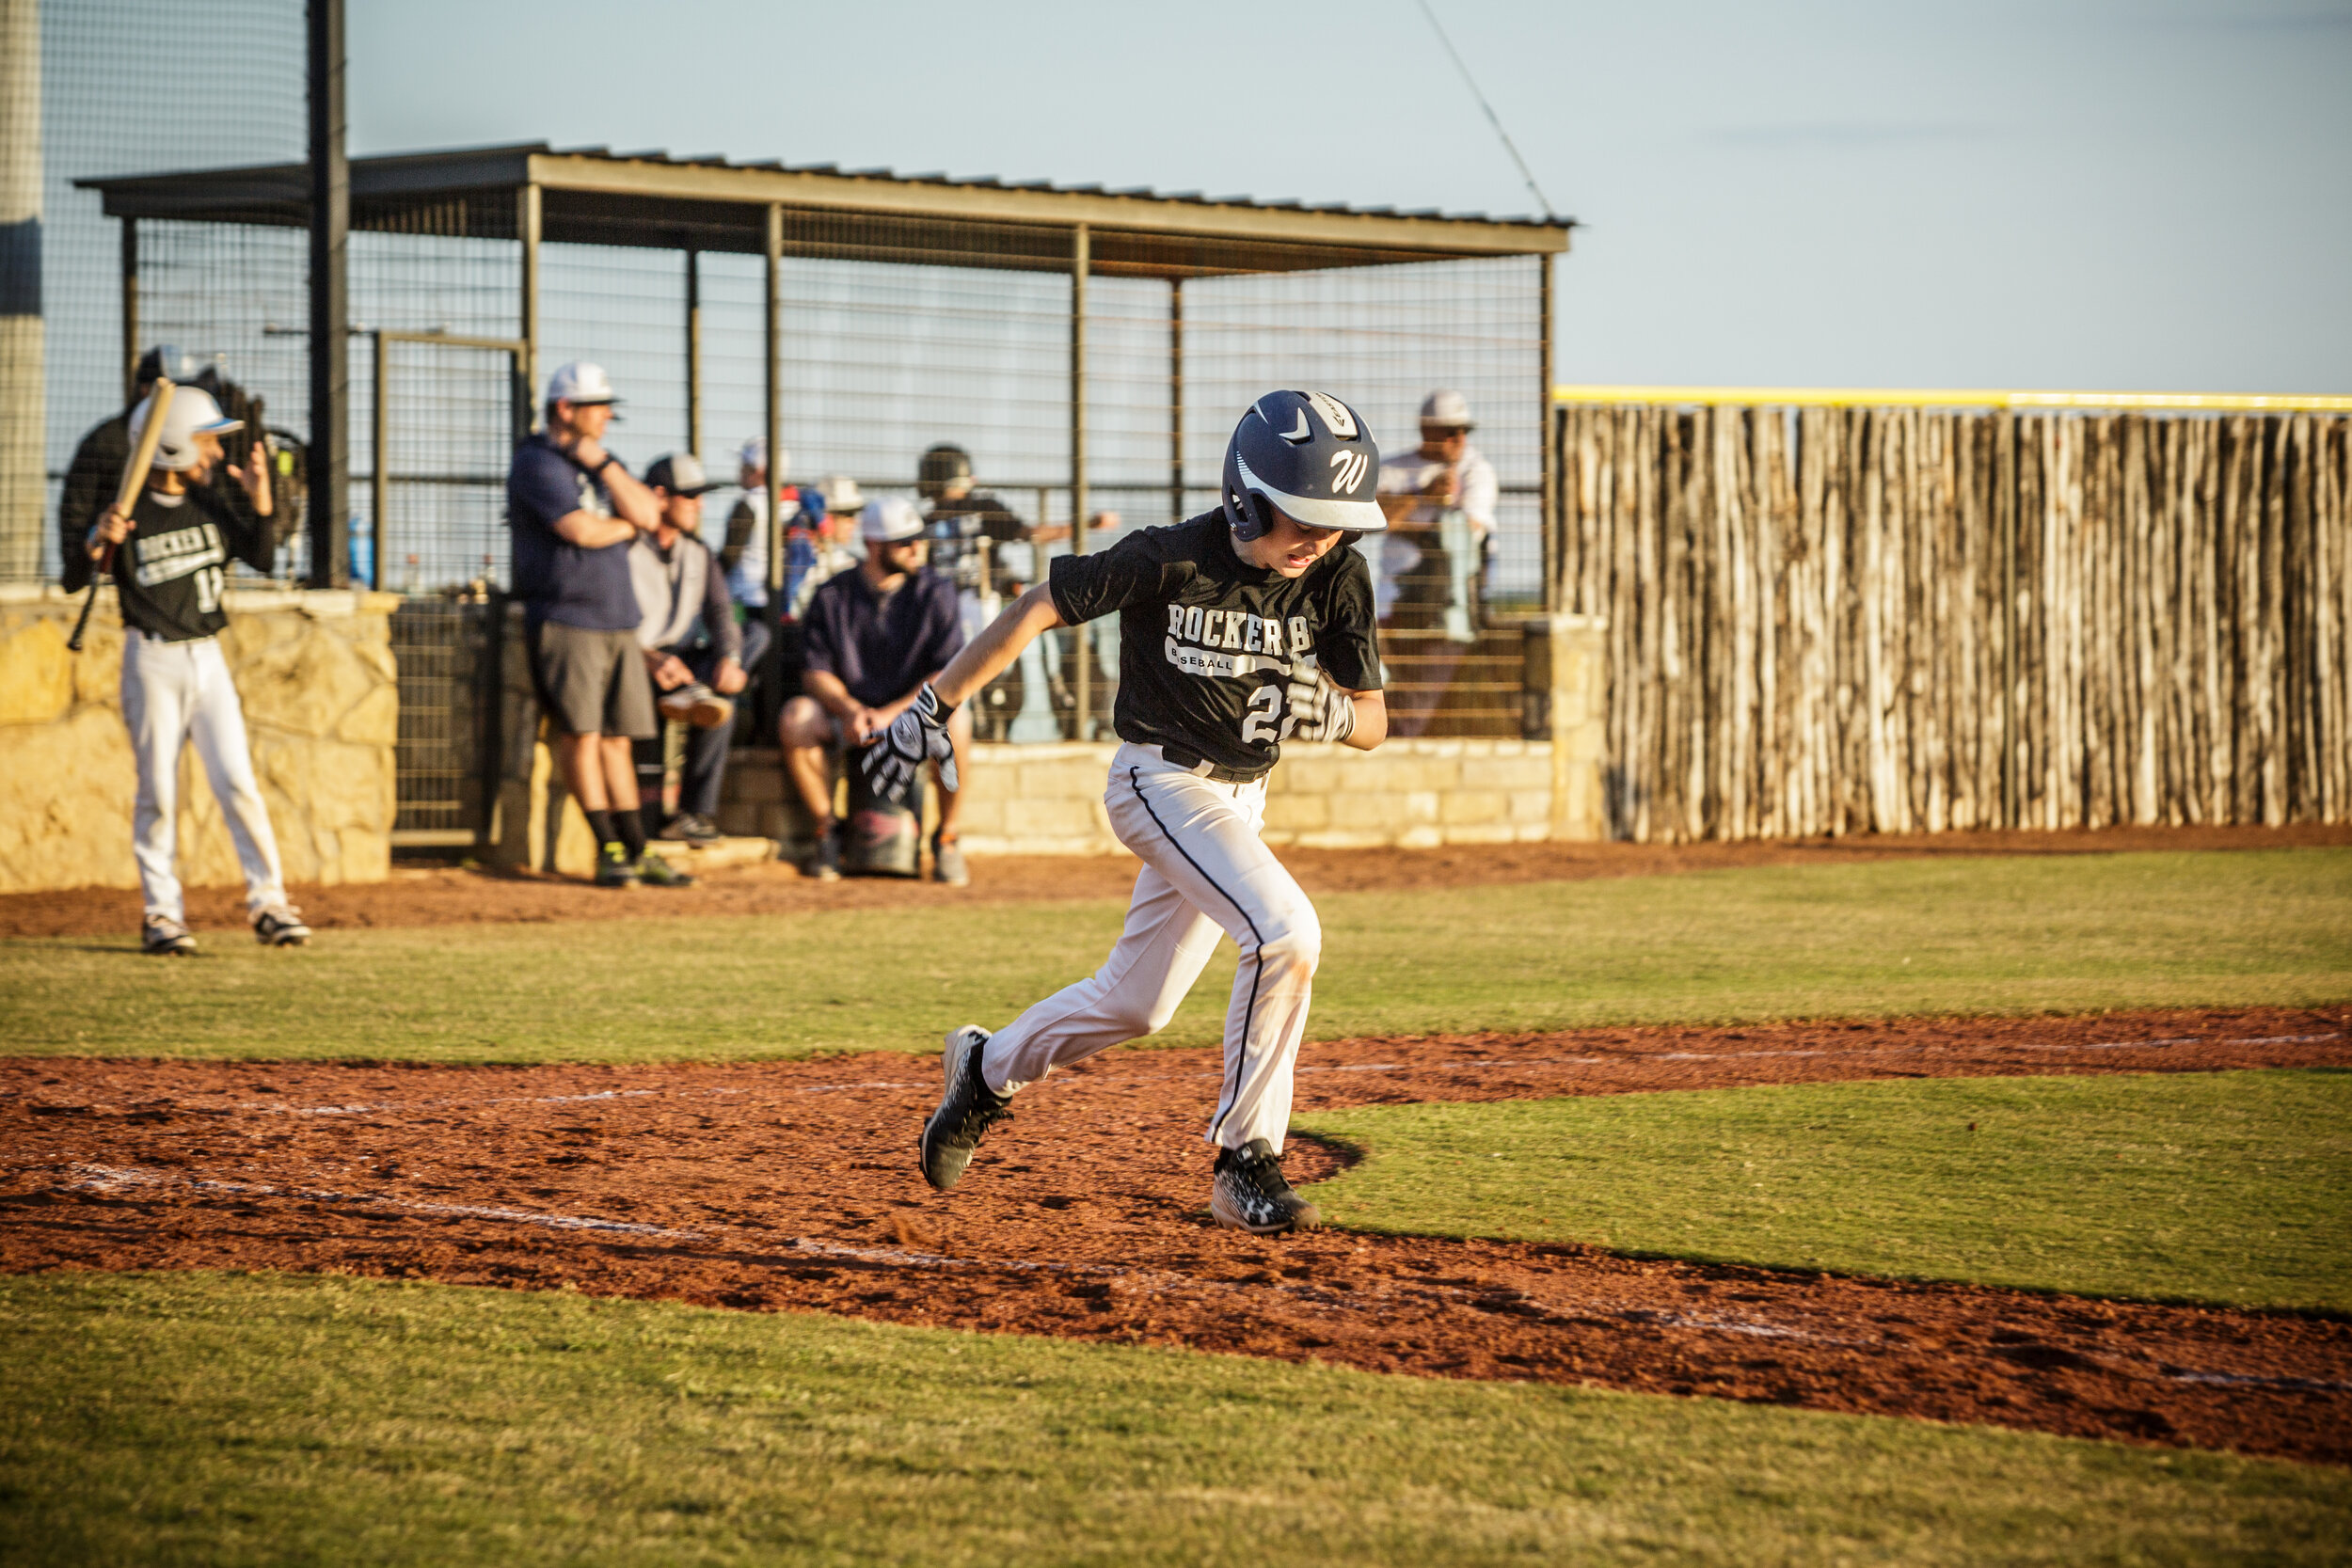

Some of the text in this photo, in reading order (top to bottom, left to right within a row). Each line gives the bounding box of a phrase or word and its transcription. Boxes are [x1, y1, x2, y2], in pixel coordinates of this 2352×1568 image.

[1314, 392, 1345, 427] EAST
[1329, 450, 1368, 494] W
[1168, 604, 1311, 656] ROCKER B
[1171, 647, 1232, 671] BSEBALL
[1242, 684, 1300, 743] 2
